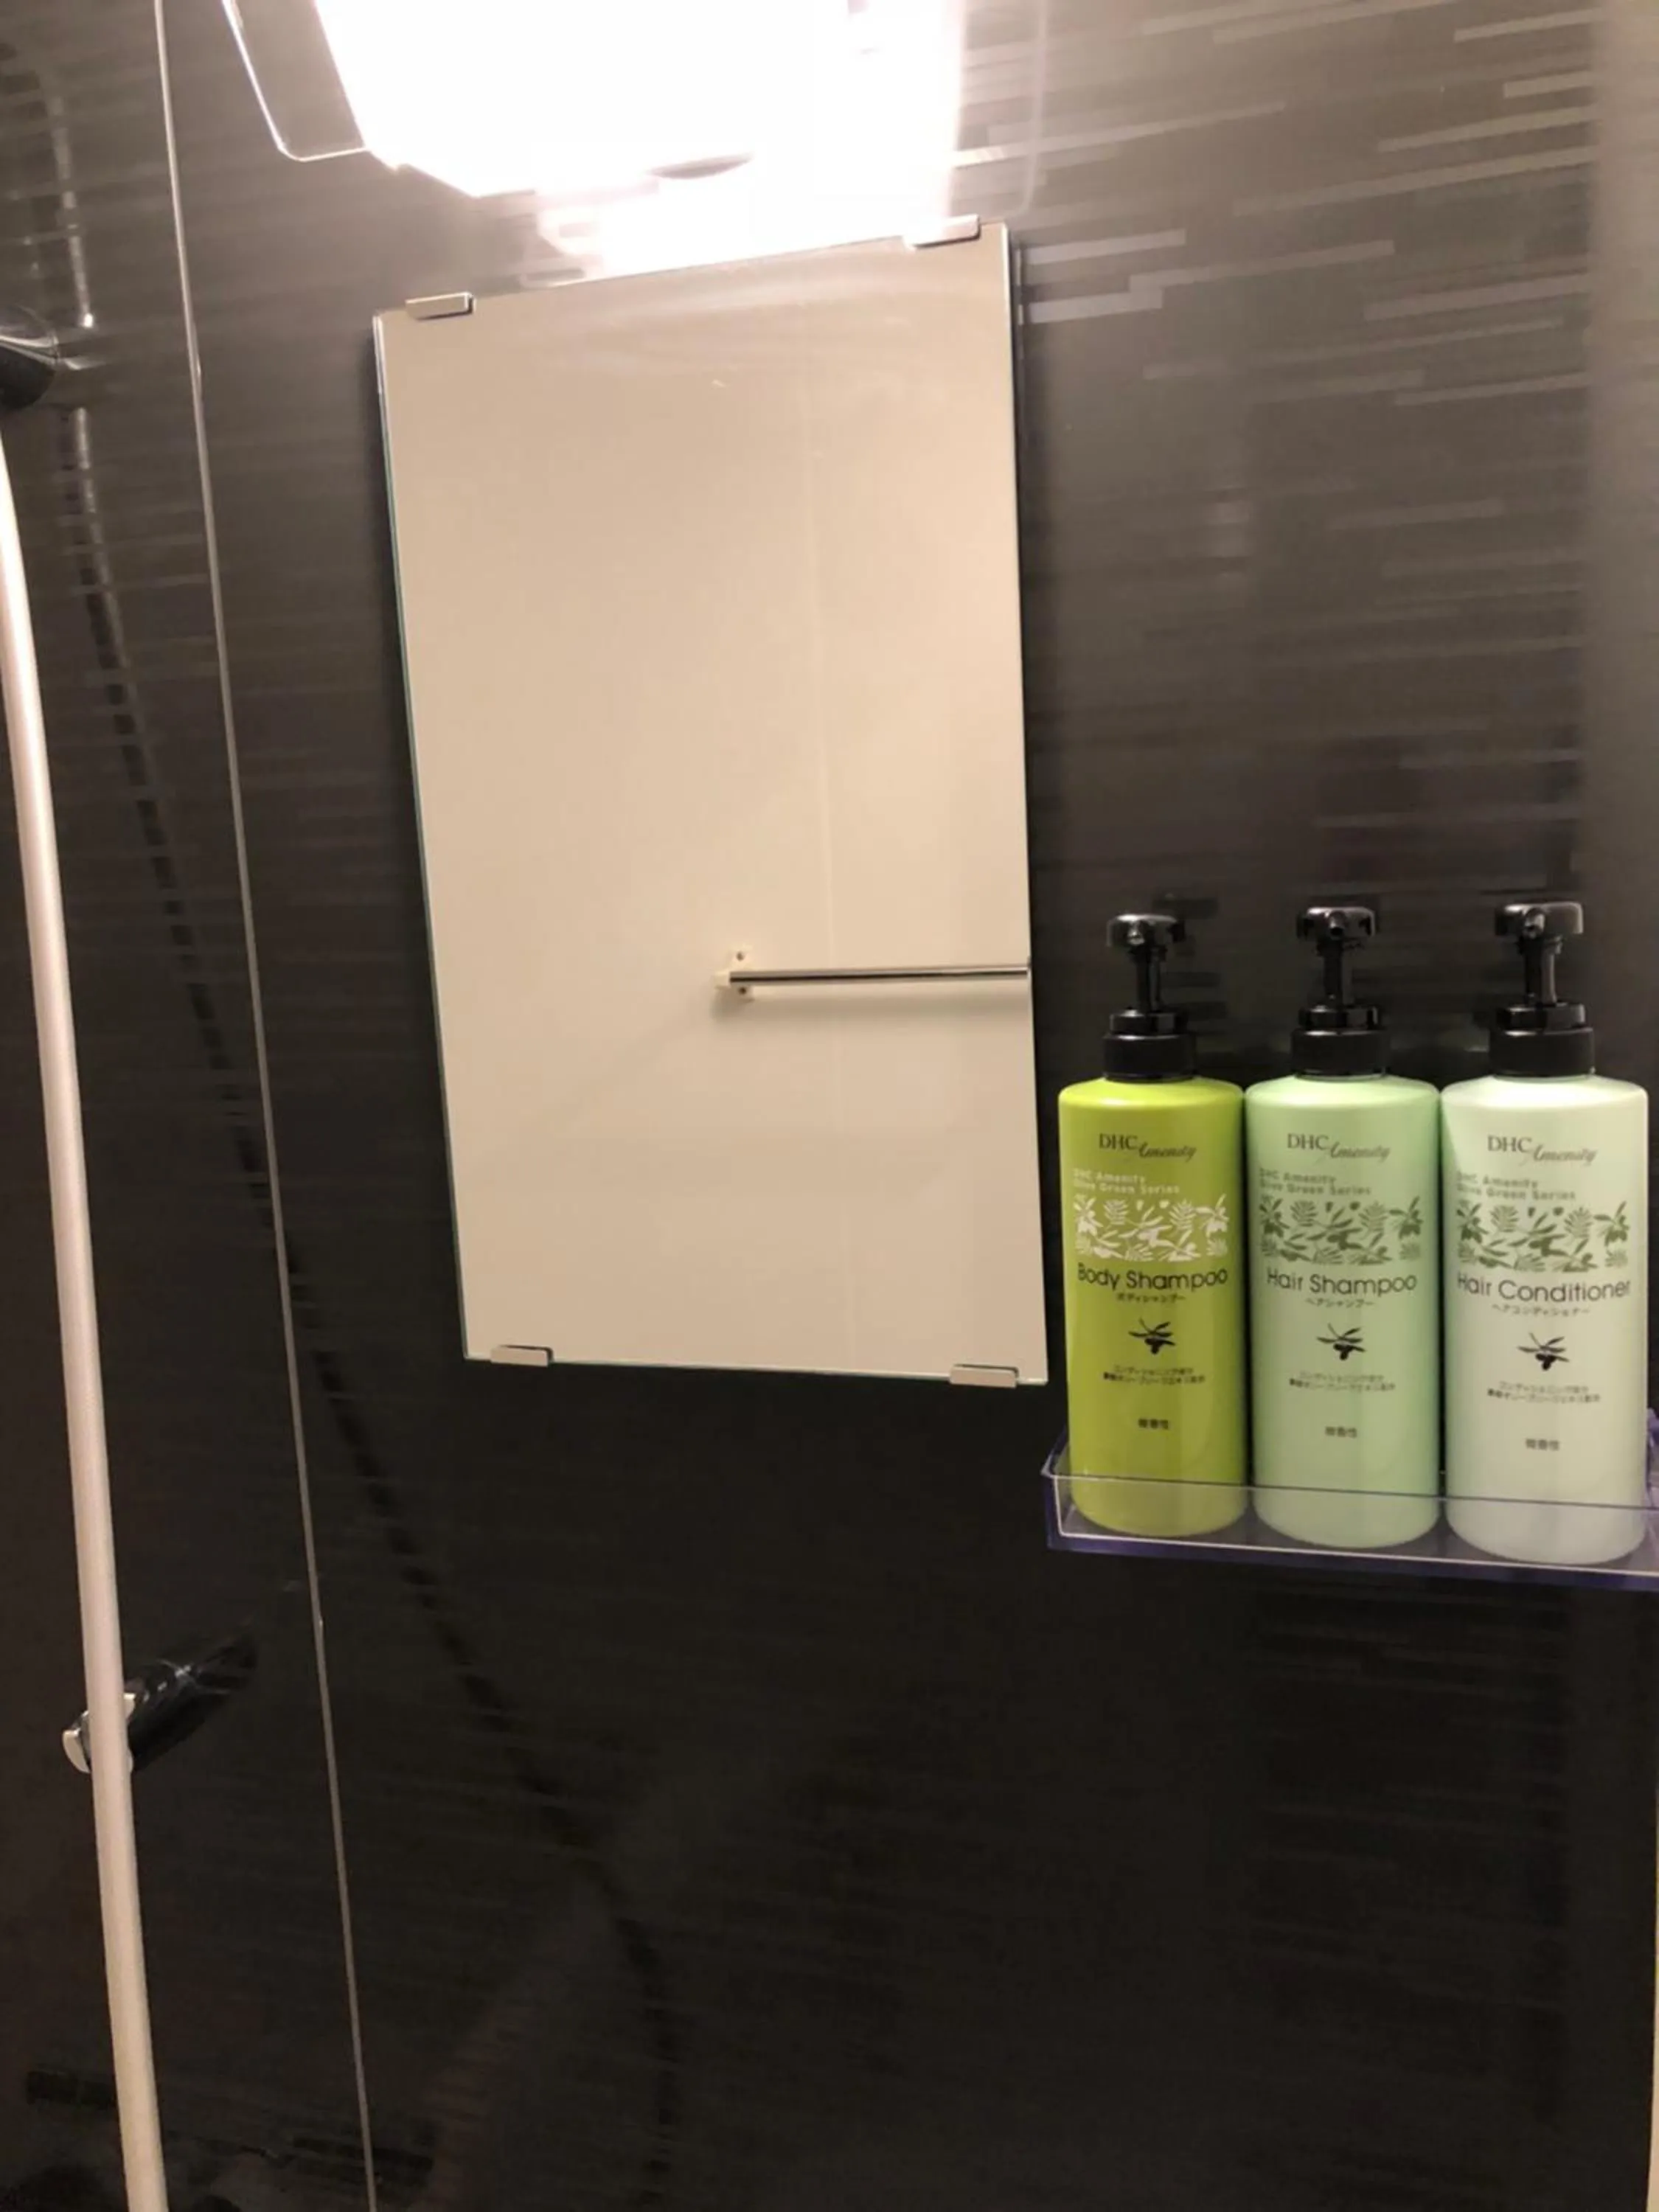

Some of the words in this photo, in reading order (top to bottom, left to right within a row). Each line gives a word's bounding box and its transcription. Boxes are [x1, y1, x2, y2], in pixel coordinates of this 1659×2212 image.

[1099, 1133, 1138, 1151] DHC
[1287, 1133, 1329, 1151] DHC
[1486, 1135, 1532, 1152] DHC
[1077, 1262, 1120, 1290] Body
[1126, 1269, 1228, 1292] Shampoo
[1266, 1267, 1304, 1290] Hair
[1310, 1273, 1418, 1297] Shampoo
[1457, 1272, 1492, 1295] Hair
[1498, 1279, 1631, 1303] Conditioner
